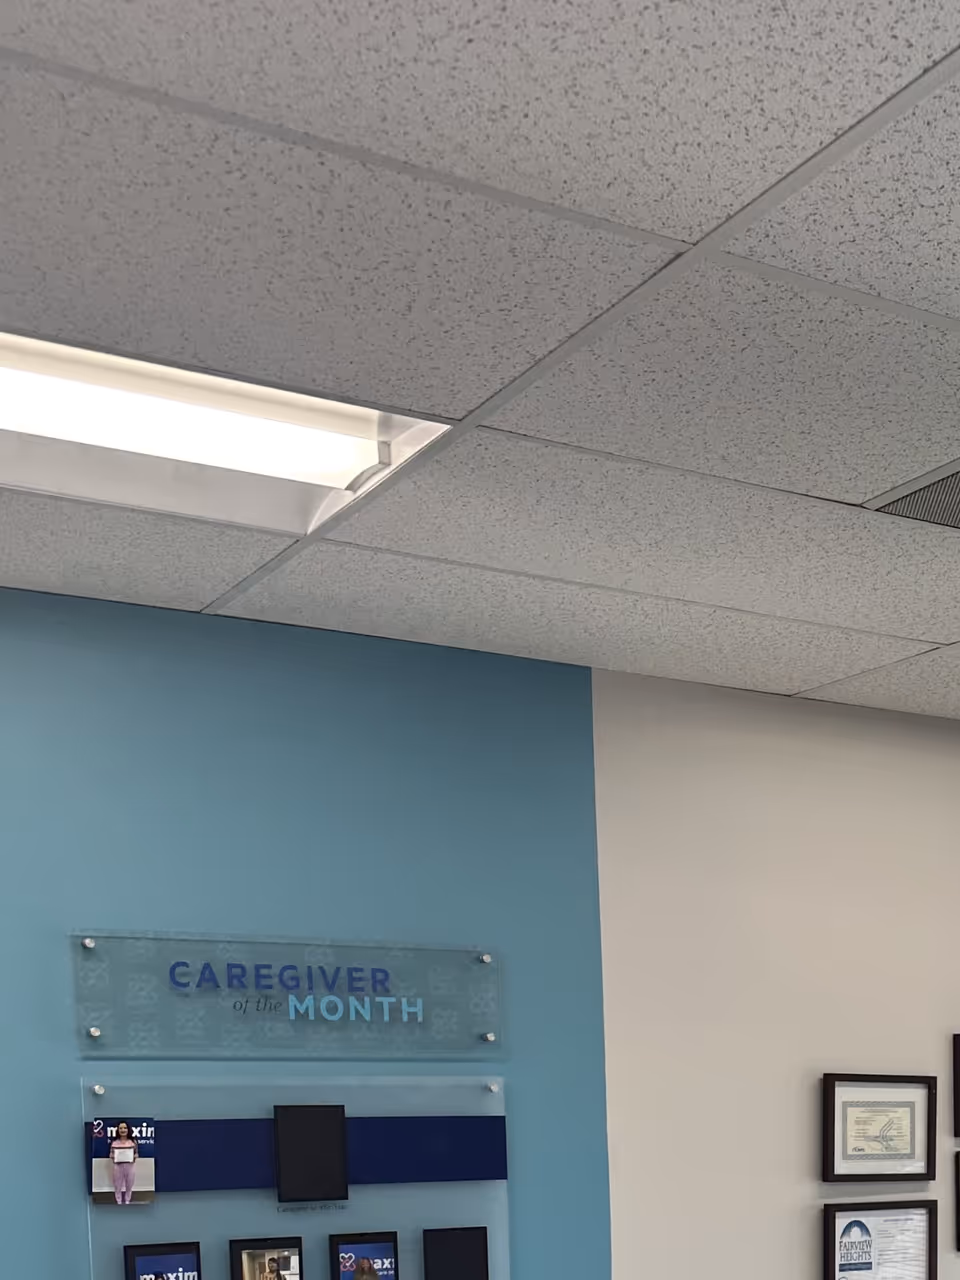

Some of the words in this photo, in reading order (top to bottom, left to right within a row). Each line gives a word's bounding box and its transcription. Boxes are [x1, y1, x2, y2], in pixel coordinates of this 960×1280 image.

[169, 961, 391, 993] CAREGIVER
[233, 998, 250, 1016] of
[256, 995, 282, 1013] the
[289, 995, 424, 1023] MONTH
[839, 1240, 872, 1251] FAIRVIEW
[840, 1252, 872, 1262] HEIGHTS
